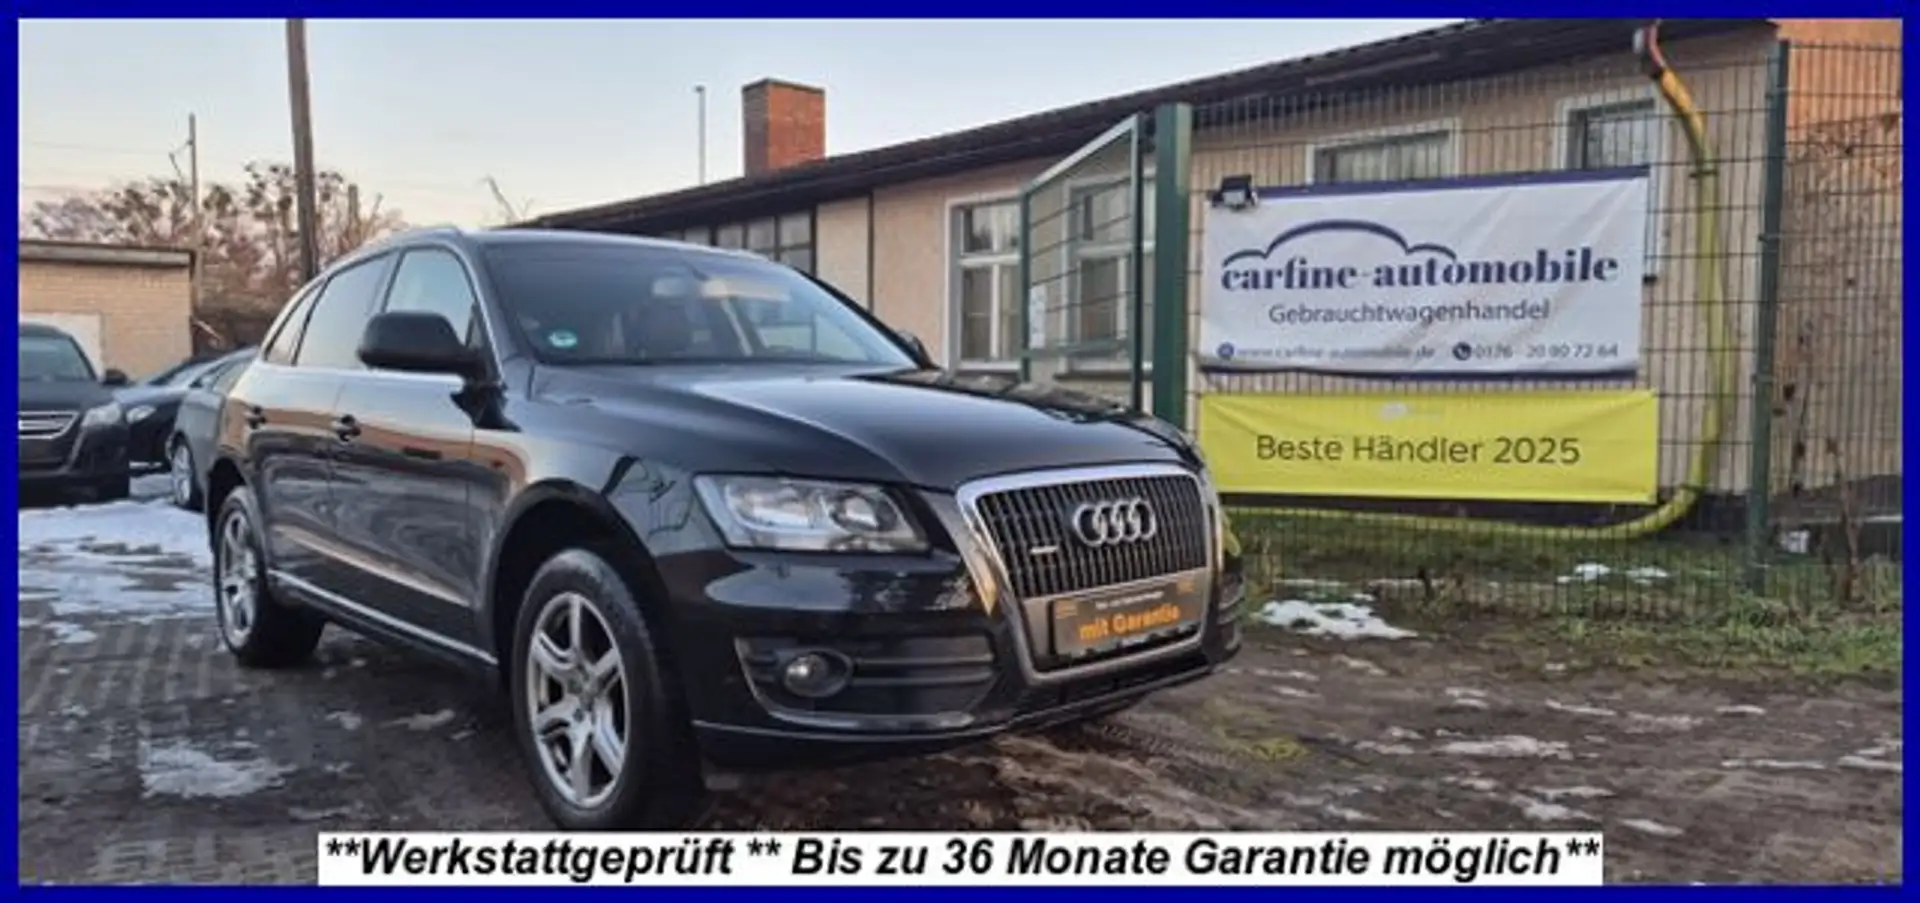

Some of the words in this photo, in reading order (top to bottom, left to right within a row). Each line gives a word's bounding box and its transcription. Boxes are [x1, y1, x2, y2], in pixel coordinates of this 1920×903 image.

[1221, 248, 1618, 291] carfine-automobile
[1269, 301, 1550, 325] Gebrauchtwagenhandel
[1257, 435, 1342, 461] Beste
[1353, 435, 1484, 464] Händler
[1494, 437, 1580, 464] 2025
[1079, 617, 1110, 640] mit
[1112, 602, 1181, 635] Garantie
